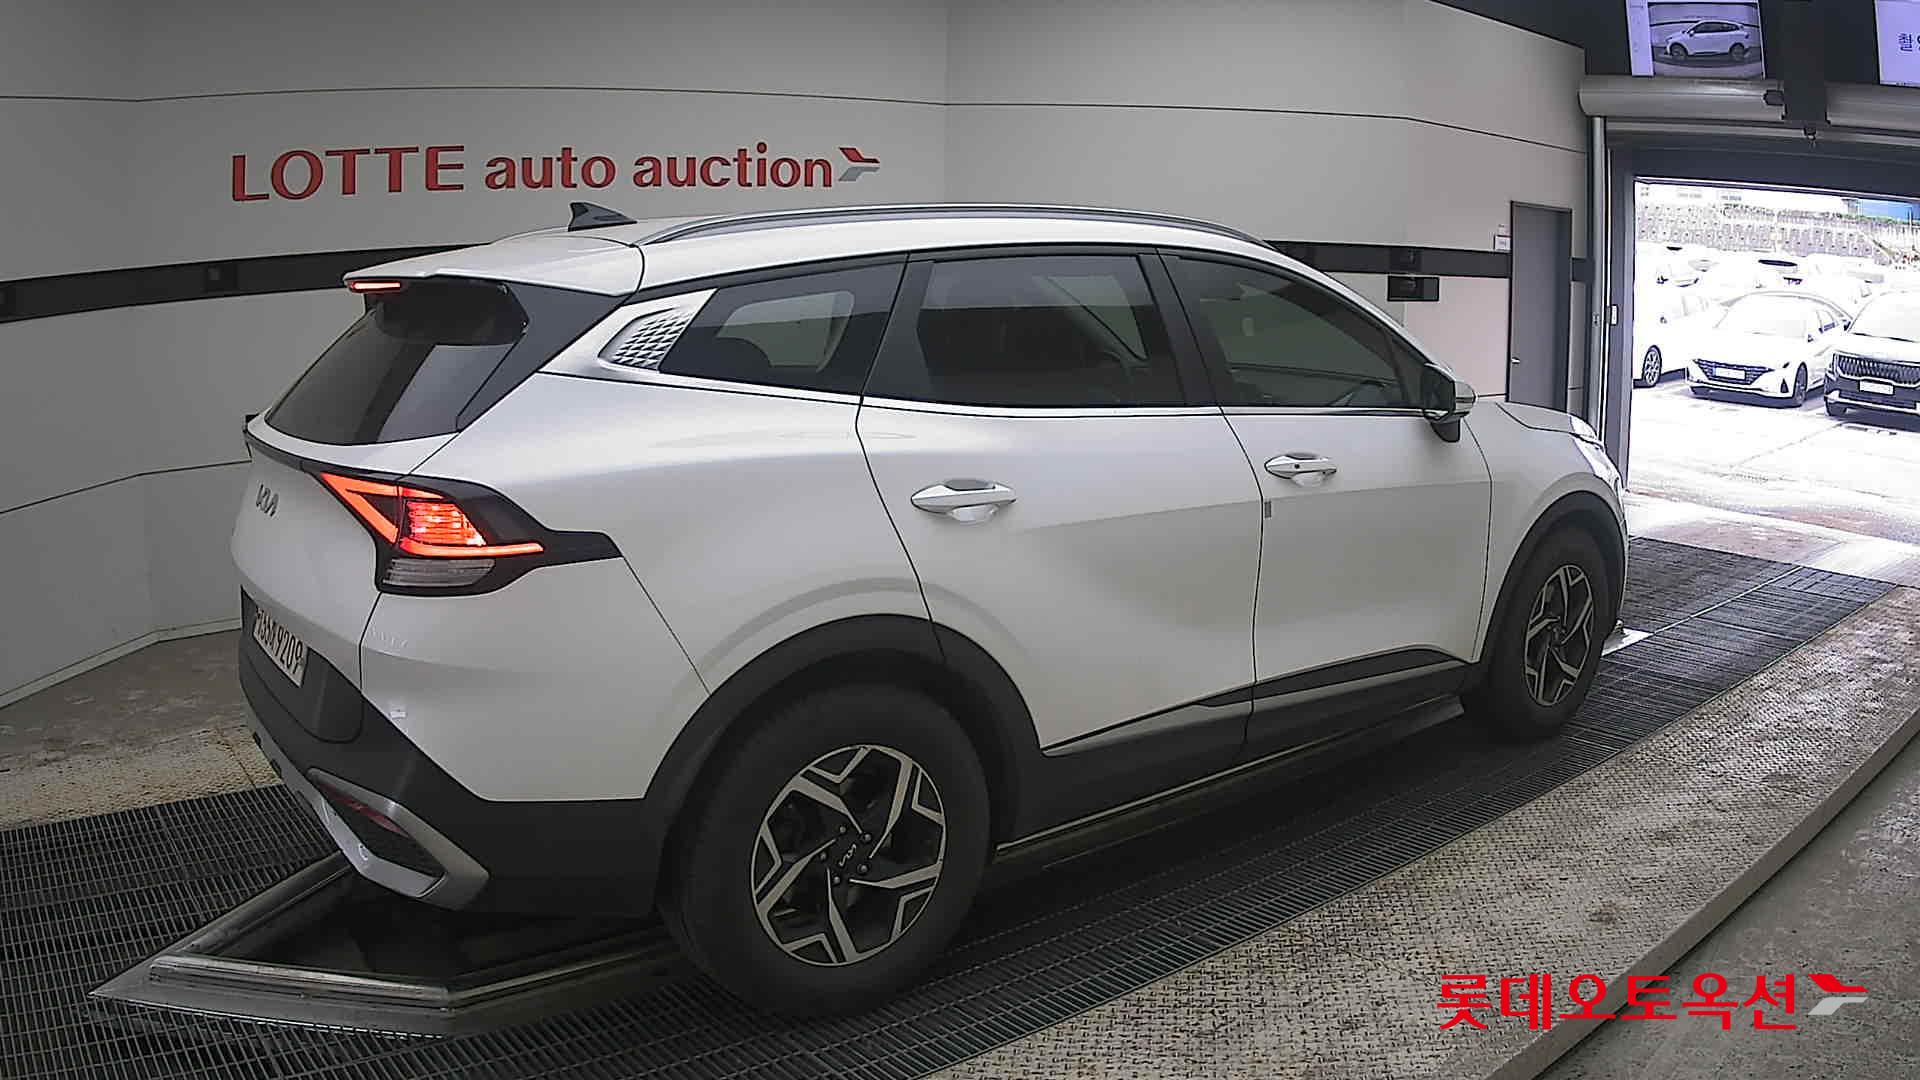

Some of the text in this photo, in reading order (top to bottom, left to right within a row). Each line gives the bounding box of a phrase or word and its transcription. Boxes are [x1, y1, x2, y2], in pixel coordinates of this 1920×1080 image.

[232, 142, 833, 201] LOTTE auto auction
